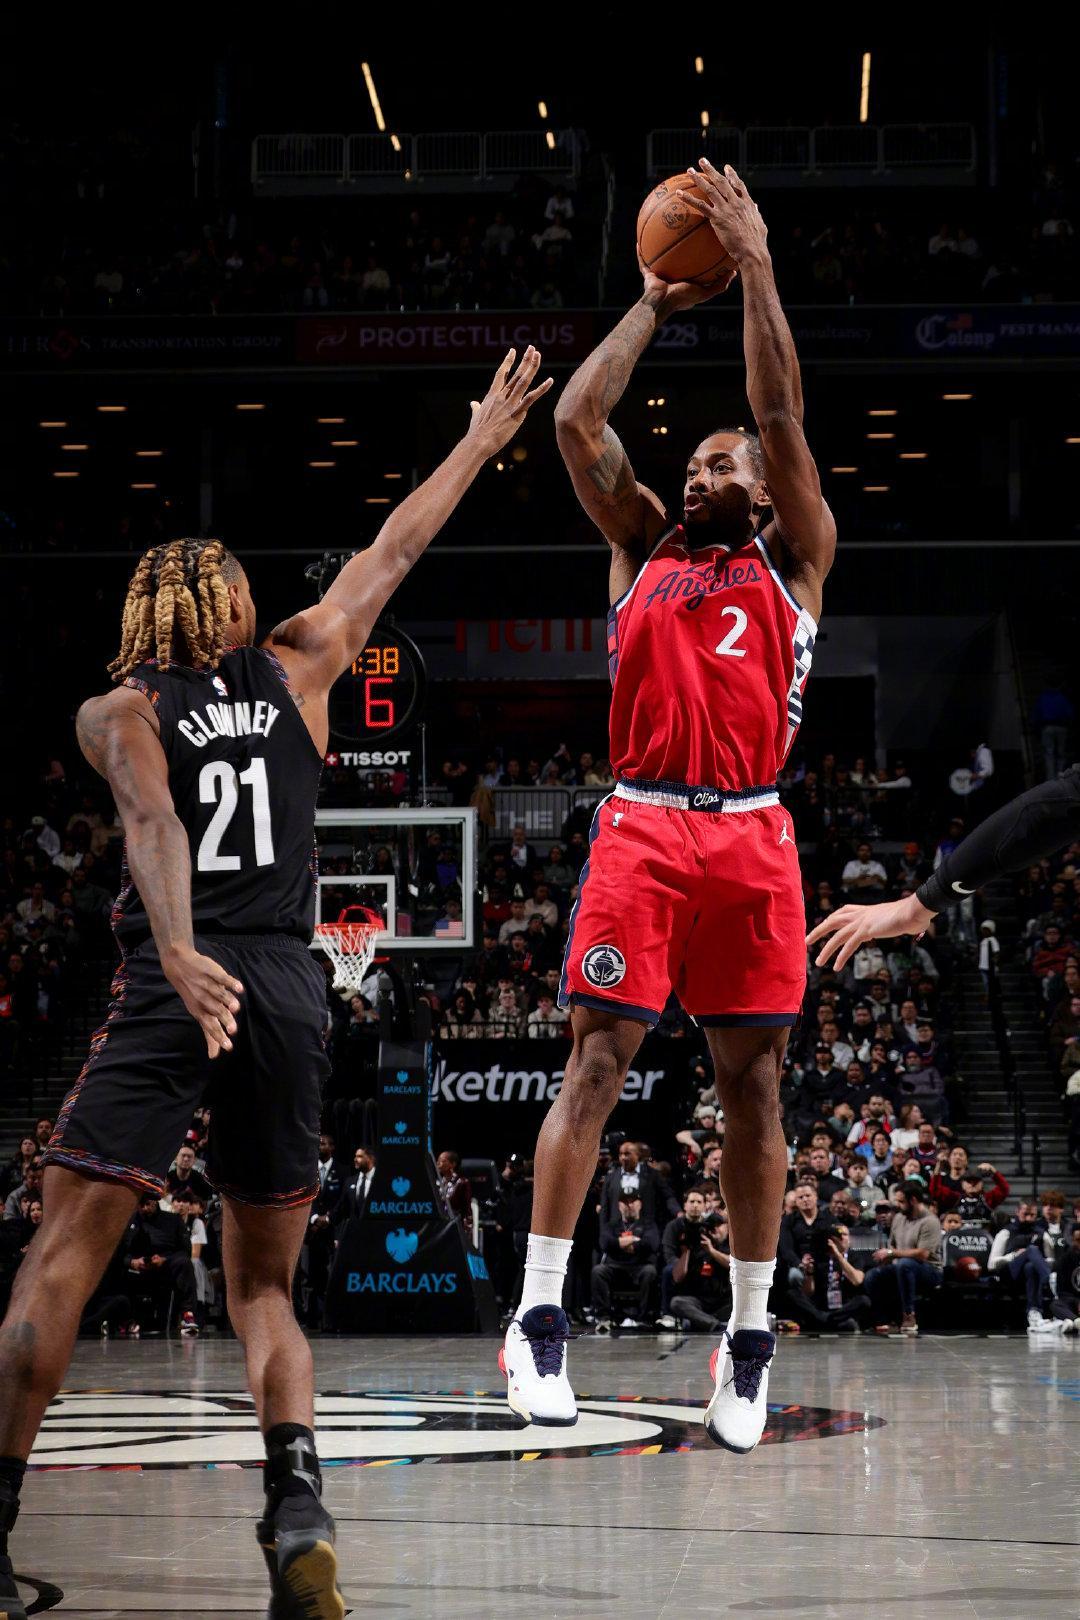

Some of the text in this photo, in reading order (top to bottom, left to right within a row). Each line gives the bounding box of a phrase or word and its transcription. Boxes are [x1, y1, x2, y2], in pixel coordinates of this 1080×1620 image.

[359, 324, 576, 348] PROTECTLLC.US
[715, 605, 748, 658] 2
[365, 677, 395, 728] 6
[177, 700, 281, 748] CLOWNEY
[340, 750, 412, 767] TISSOT
[693, 792, 720, 807] Clips
[197, 757, 275, 872] 21
[383, 1084, 422, 1094] BARCLAYS
[382, 1135, 420, 1145] BARCLAYS
[369, 1200, 433, 1214] BARCLAYS
[948, 1234, 988, 1247] QATAR
[345, 1271, 458, 1293] BARCLAYS
